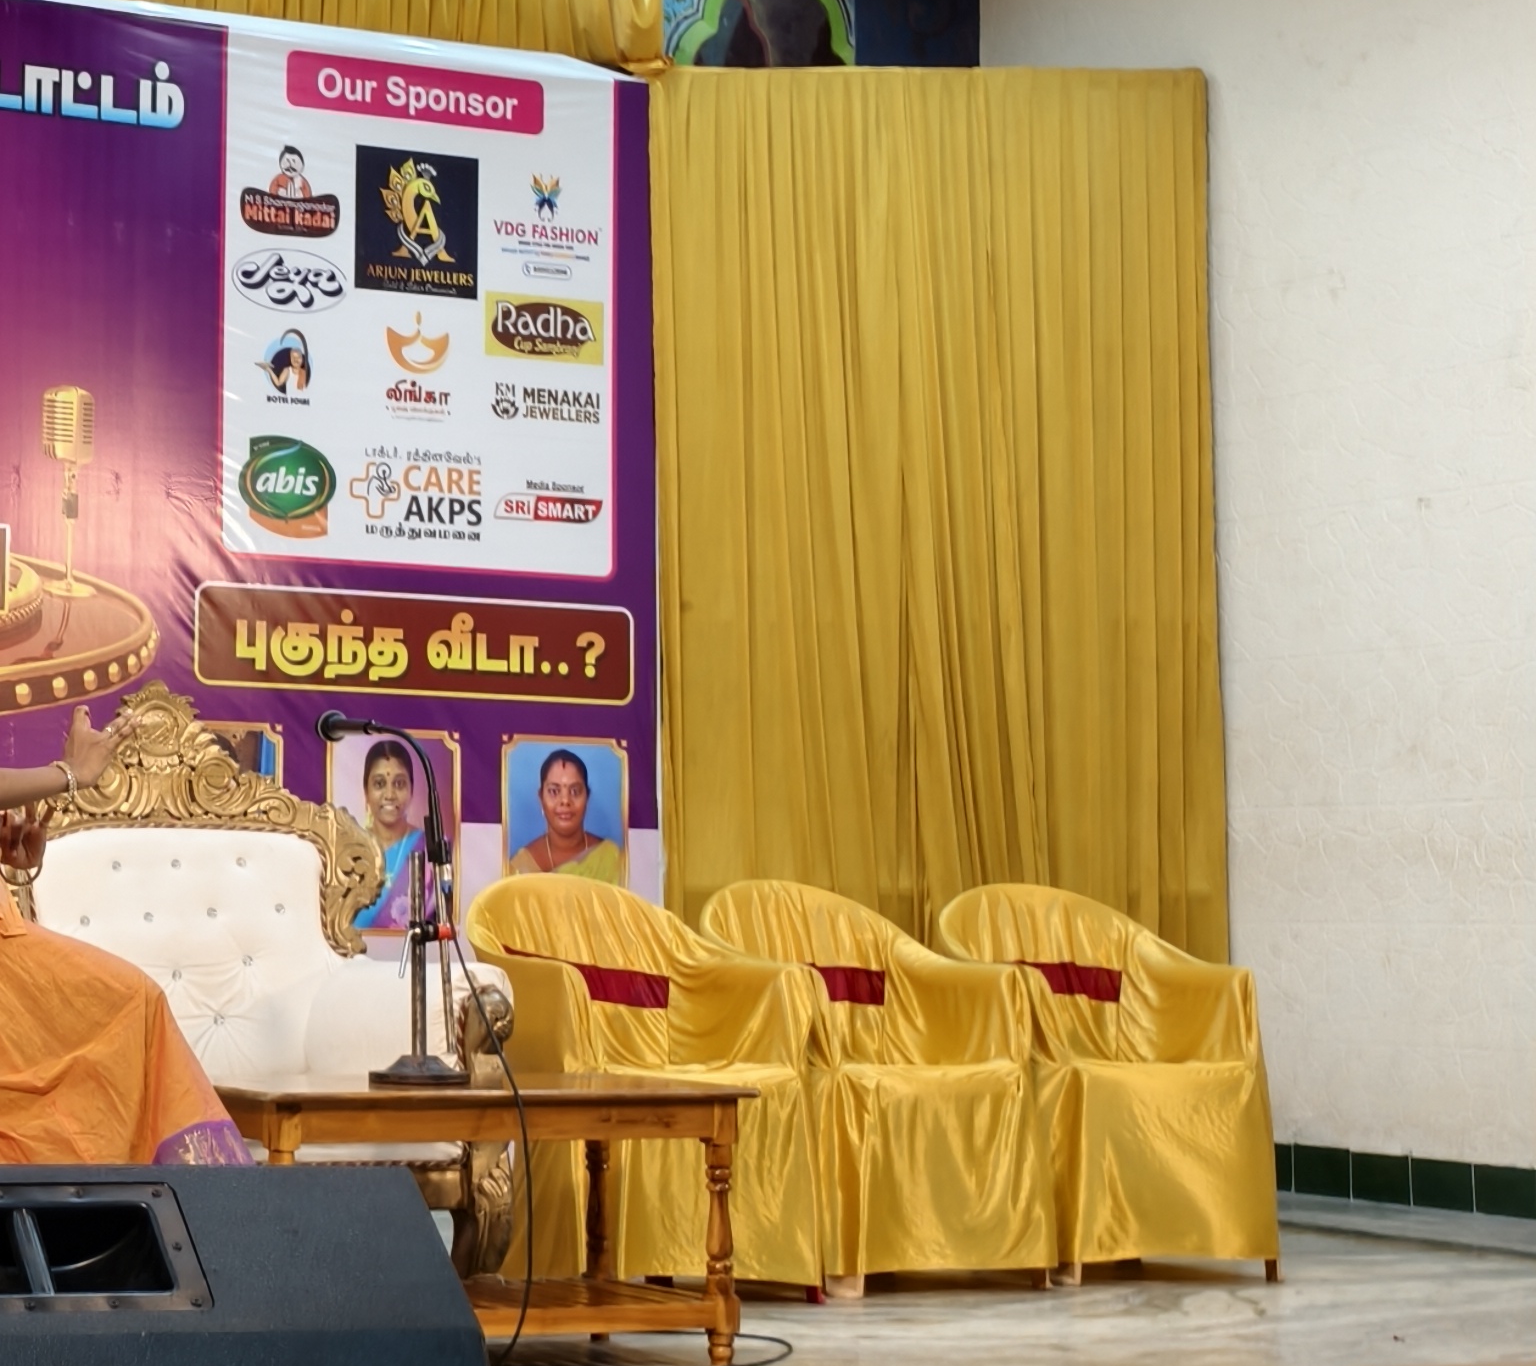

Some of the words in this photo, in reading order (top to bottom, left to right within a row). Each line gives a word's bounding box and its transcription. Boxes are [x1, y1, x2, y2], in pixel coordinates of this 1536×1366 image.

[317, 67, 377, 103] Our
[386, 75, 518, 120] Sponsor
[244, 203, 290, 225] Mittai
[493, 219, 527, 238] VDG
[531, 223, 599, 247] FASHION
[367, 263, 408, 280] ARJUN
[409, 267, 475, 287] JEWELLERS
[495, 299, 597, 343] Radha
[522, 385, 600, 410] MENAKAI
[522, 405, 601, 425] JEWELLERS
[255, 465, 319, 497] abis
[402, 464, 482, 497] CARE
[403, 494, 482, 527] AKPS
[537, 500, 597, 521] SMART
[234, 608, 410, 682] புகுந்த
